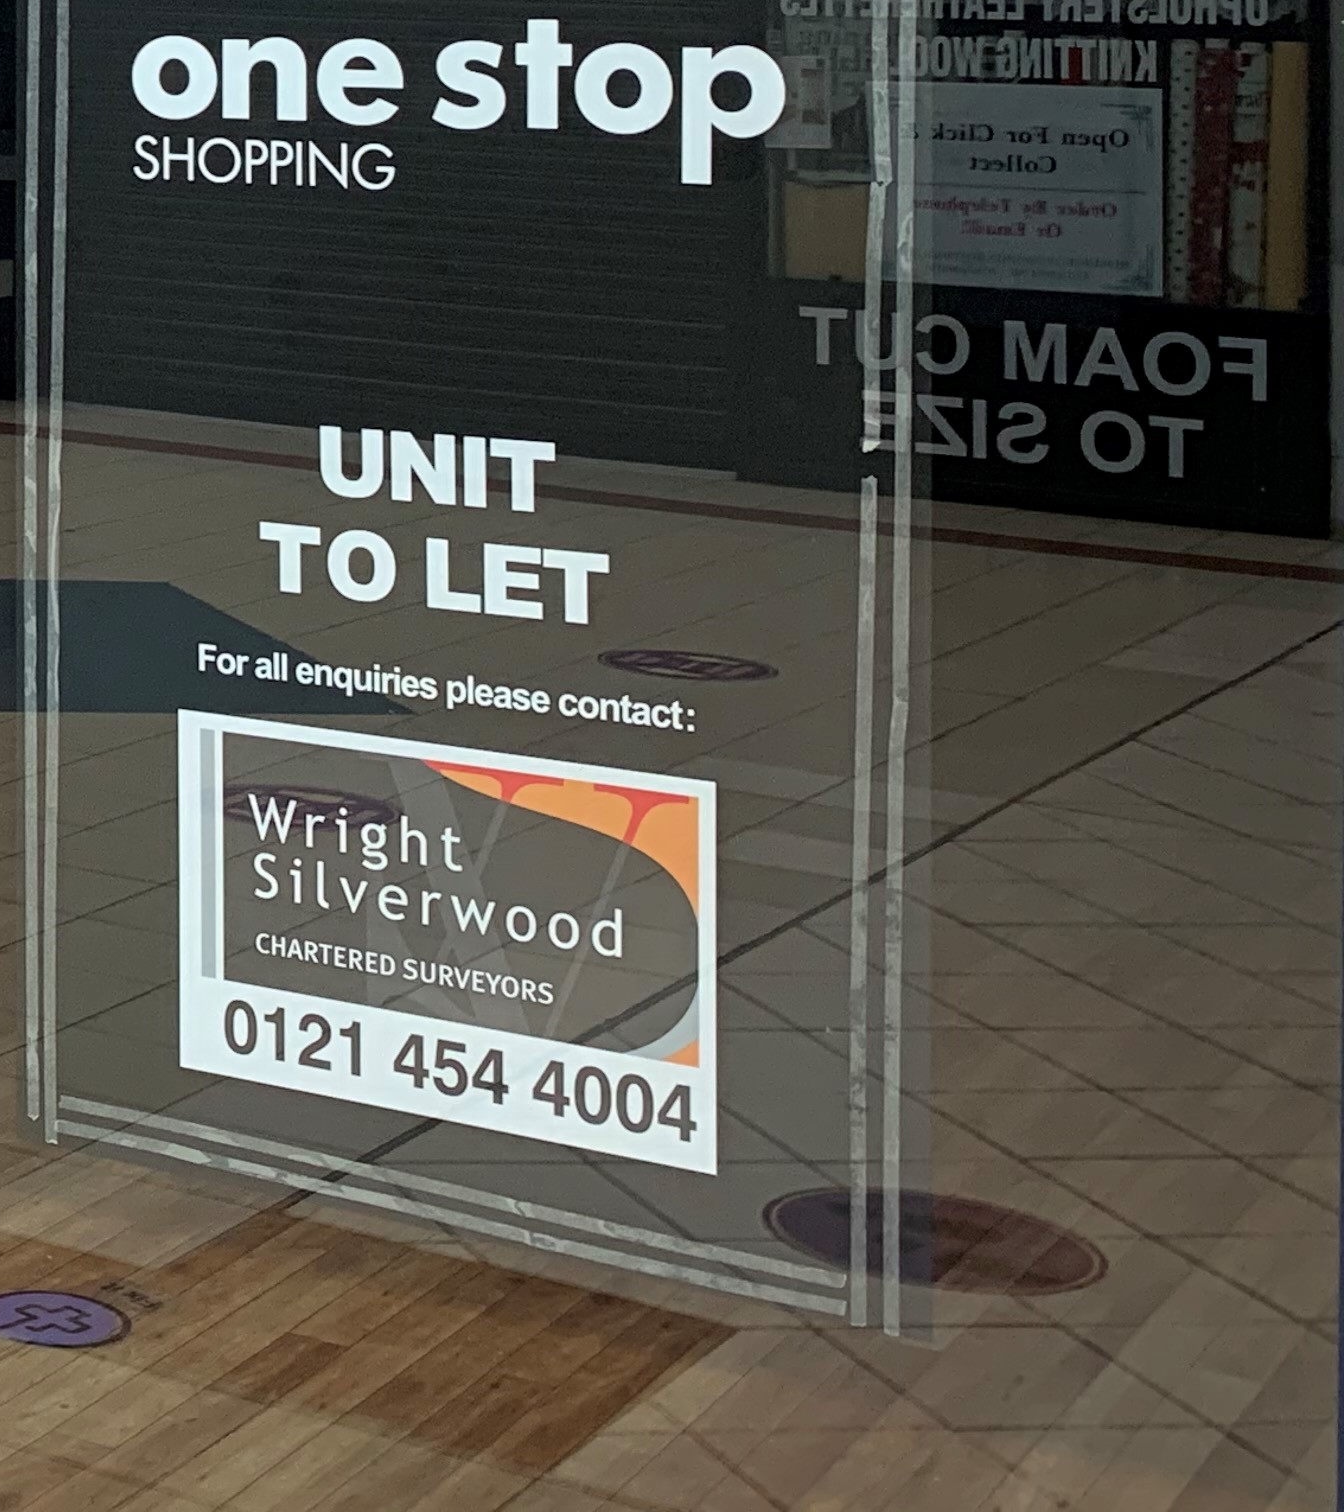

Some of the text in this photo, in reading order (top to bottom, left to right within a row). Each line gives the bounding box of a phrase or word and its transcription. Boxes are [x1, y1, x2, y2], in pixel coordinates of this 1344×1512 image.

[130, 34, 405, 126] one
[431, 18, 787, 186] stop
[132, 134, 398, 190] SHOPPING
[318, 424, 556, 513] UNIT
[258, 520, 611, 625] TO LET
[197, 642, 696, 733] For all enquiries please contact:
[246, 792, 464, 873] Wright
[251, 852, 624, 960] Silverwood
[254, 931, 555, 1006] CHARTERED SURVEYORS
[222, 999, 698, 1144] 0121 454 4004
